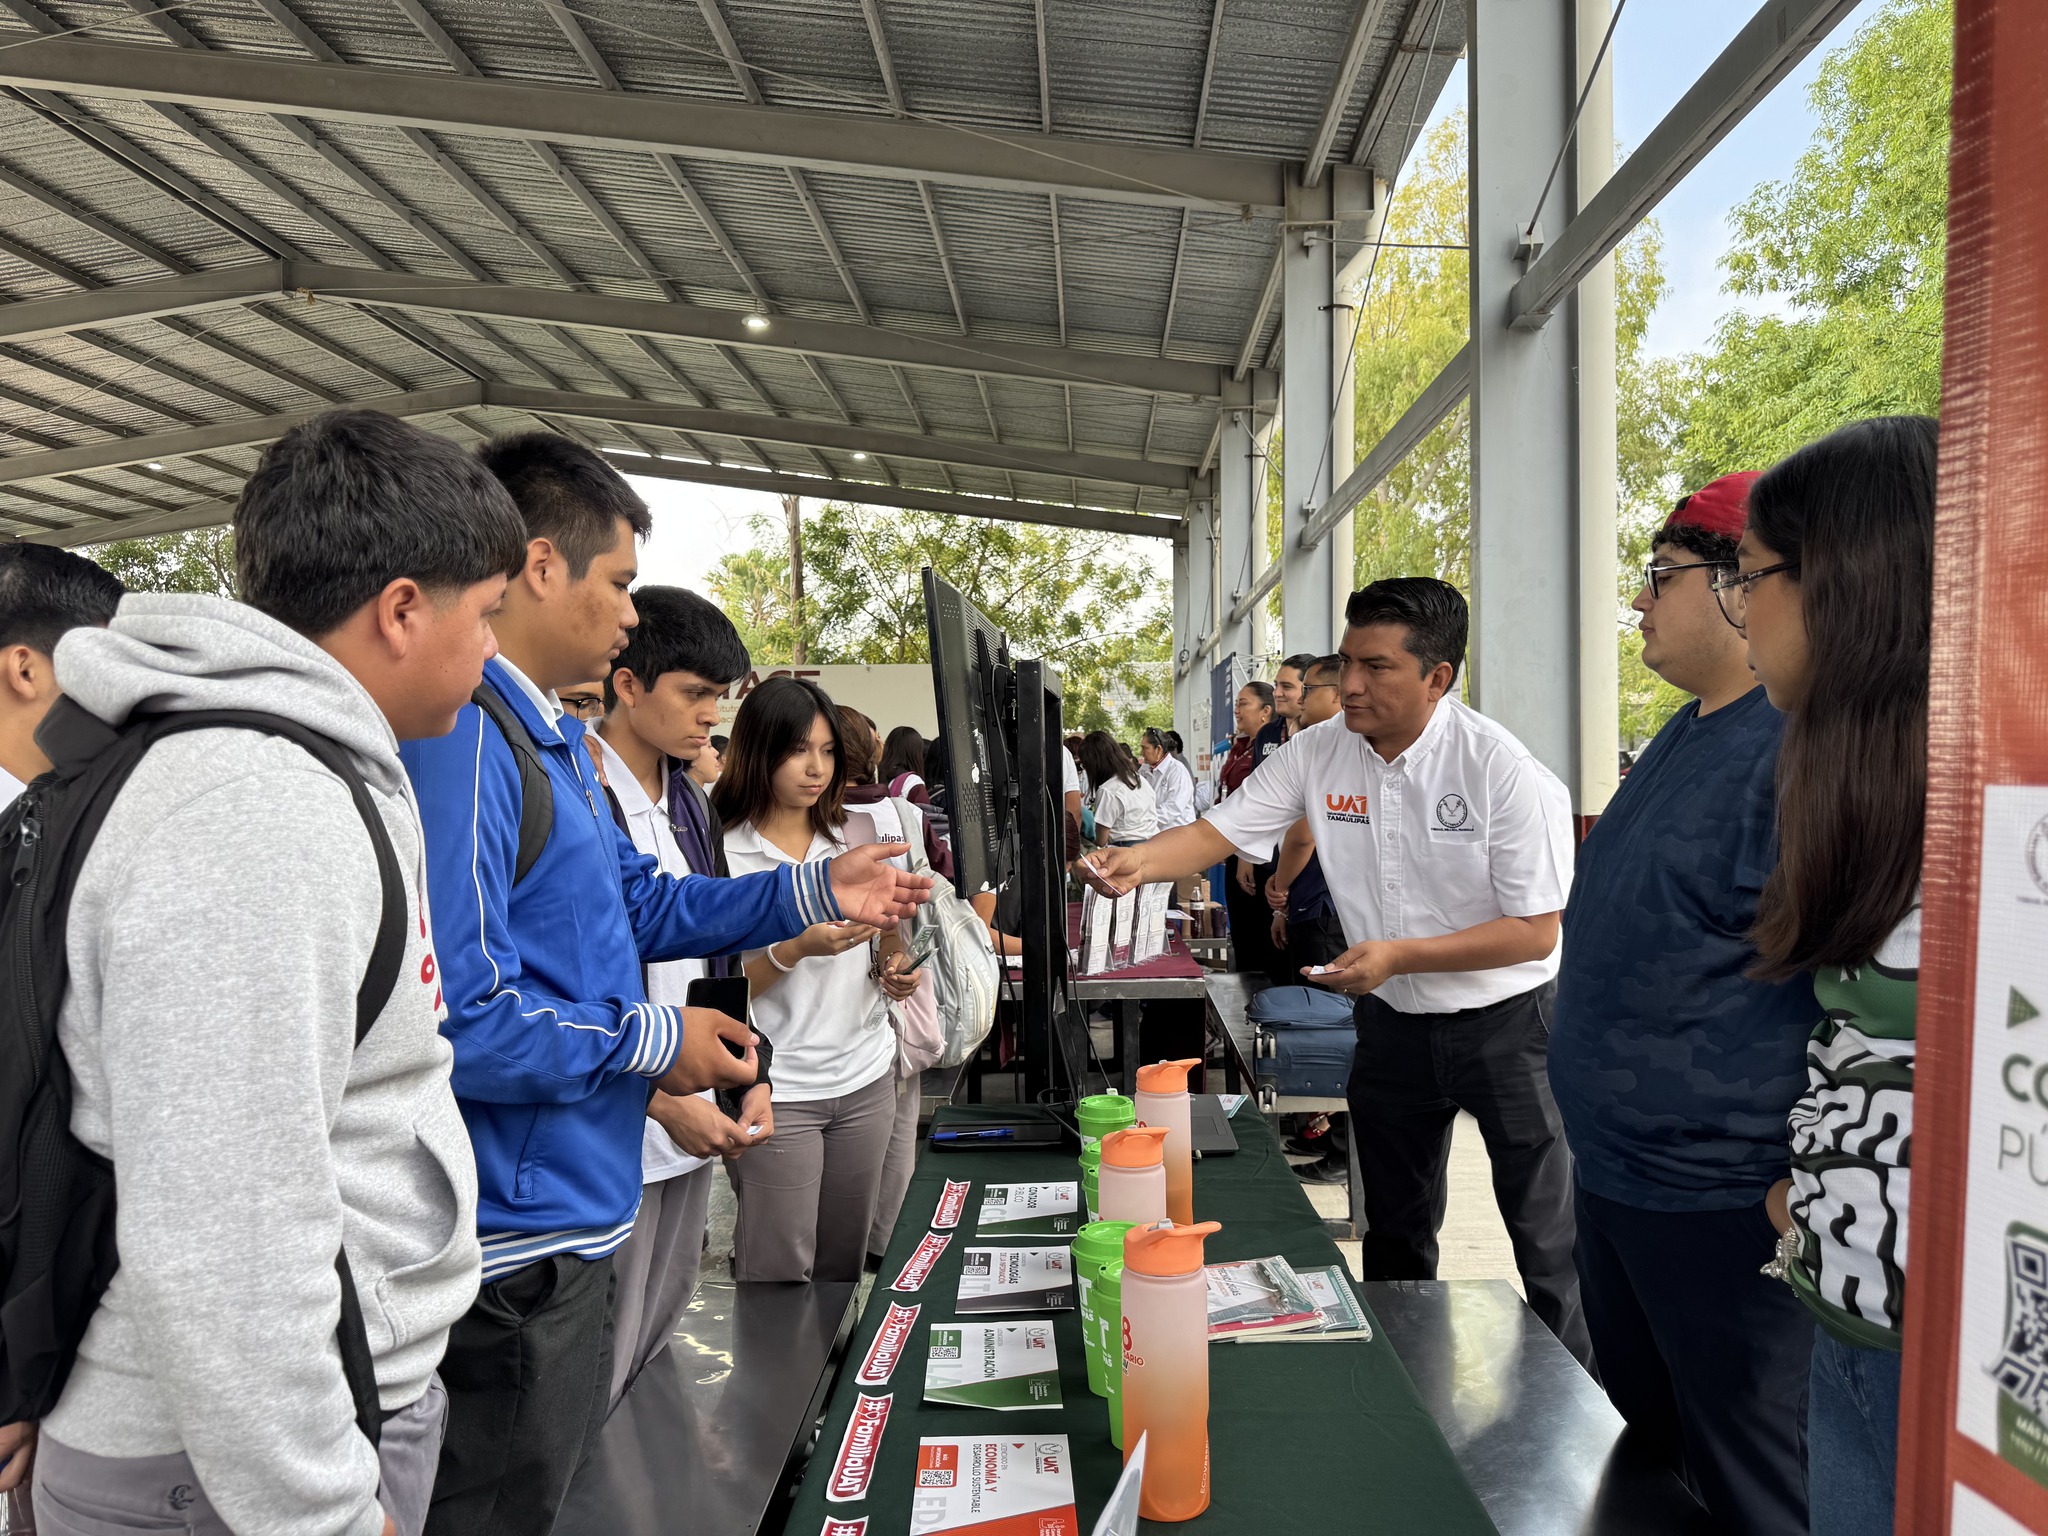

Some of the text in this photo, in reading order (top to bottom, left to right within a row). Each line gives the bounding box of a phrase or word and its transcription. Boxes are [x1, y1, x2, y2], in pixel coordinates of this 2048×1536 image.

[1326, 794, 1367, 815] UAT
[1327, 815, 1370, 825] TAMAULIPAS
[1027, 1187, 1038, 1209] CONTADOR
[1008, 1252, 1022, 1285] TECNOLOGÍAS
[866, 1307, 913, 1378] #FamiliaUAT
[984, 1328, 999, 1378] ADMINISTRACIÓN
[1032, 1337, 1046, 1349] UAT
[836, 1401, 886, 1493] #FamiliaUAT
[971, 1443, 982, 1513] DESARROLLO SUSTENTABLE
[985, 1443, 1001, 1486] ECONOMÍA
[1043, 1456, 1060, 1474] UAT
